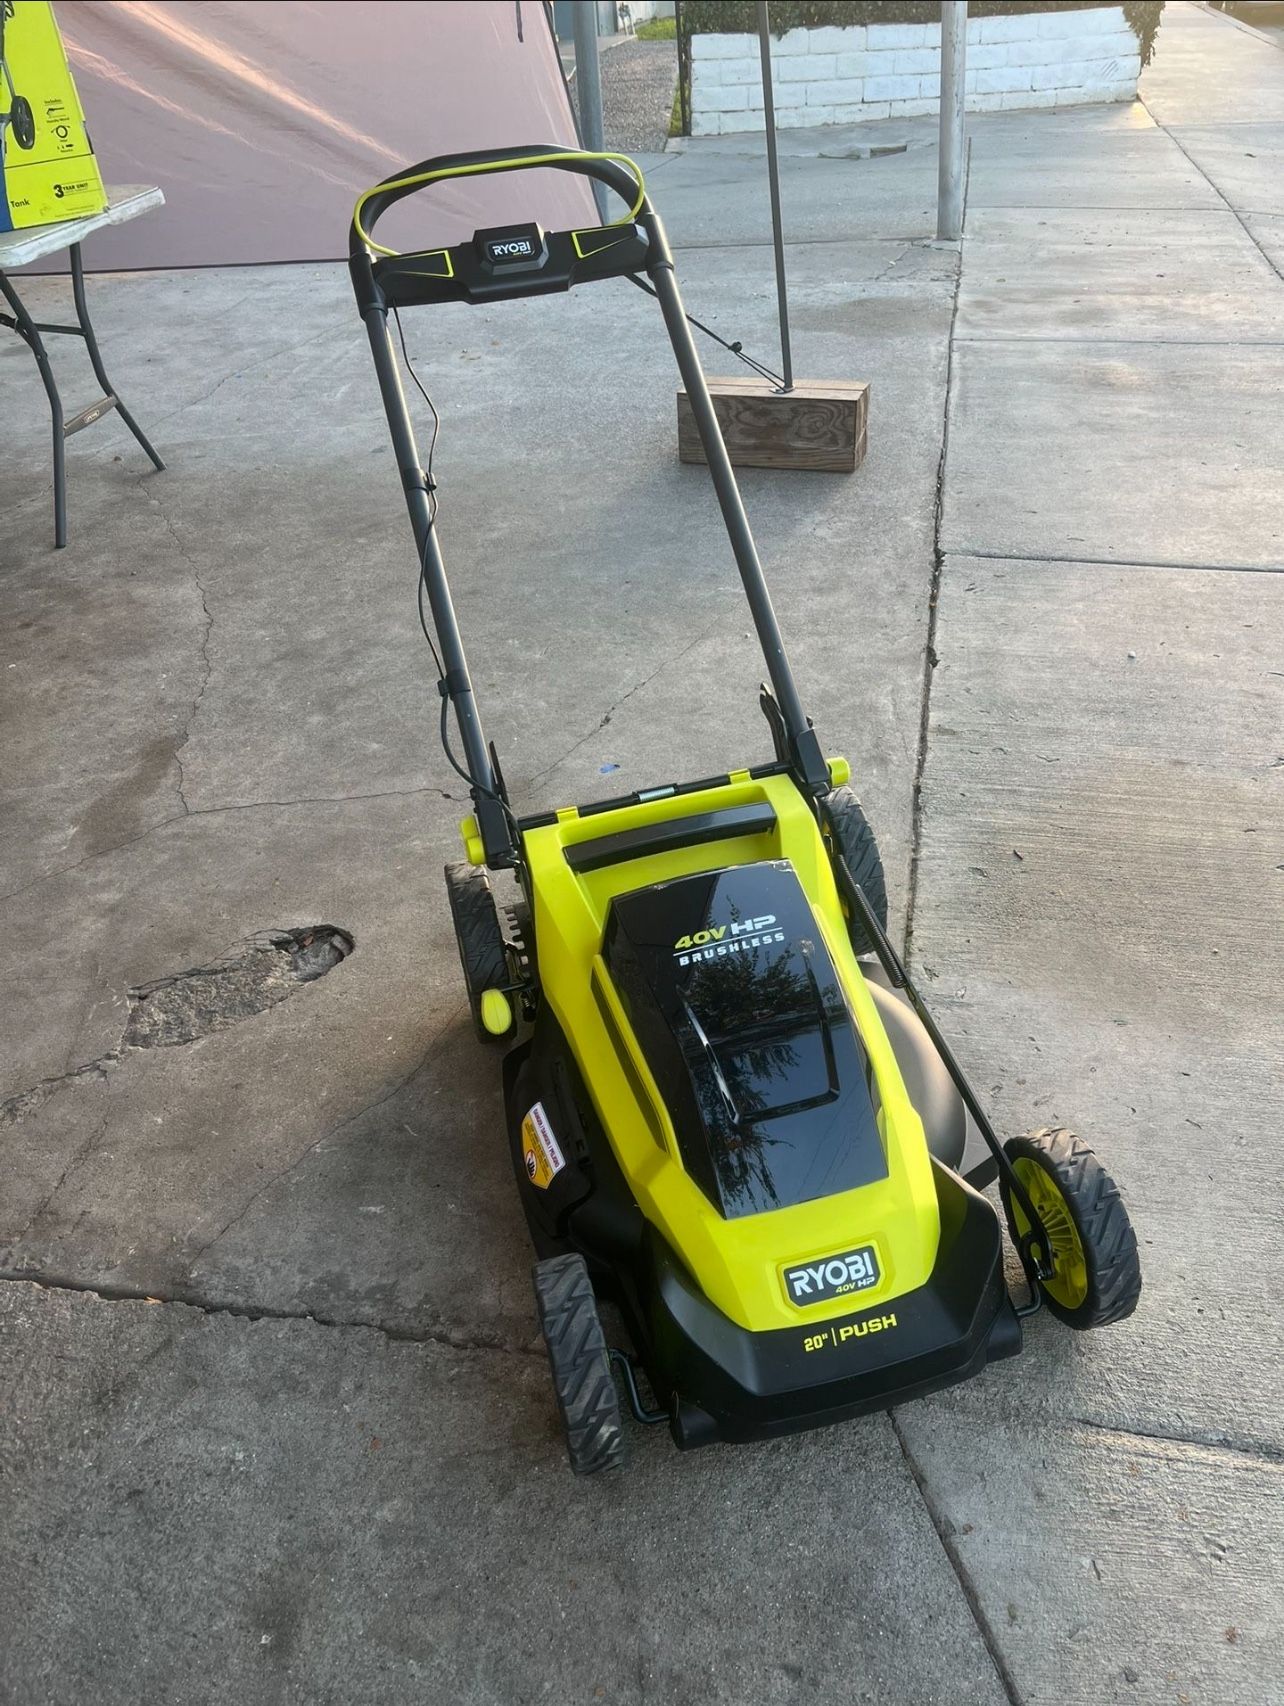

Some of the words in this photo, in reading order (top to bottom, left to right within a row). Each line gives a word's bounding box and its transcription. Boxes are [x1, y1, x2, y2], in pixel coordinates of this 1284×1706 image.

[10, 198, 30, 208] Tank
[53, 184, 65, 198] 3
[492, 241, 531, 256] RYOBI
[674, 925, 727, 950] 40V
[730, 914, 777, 935] HP
[679, 932, 785, 967] BRUSHLESS
[789, 1251, 874, 1297] RYOBI
[835, 1282, 856, 1294] 40V
[857, 1276, 875, 1288] HP
[803, 1333, 829, 1352] 20"
[839, 1313, 898, 1342] PUSH
